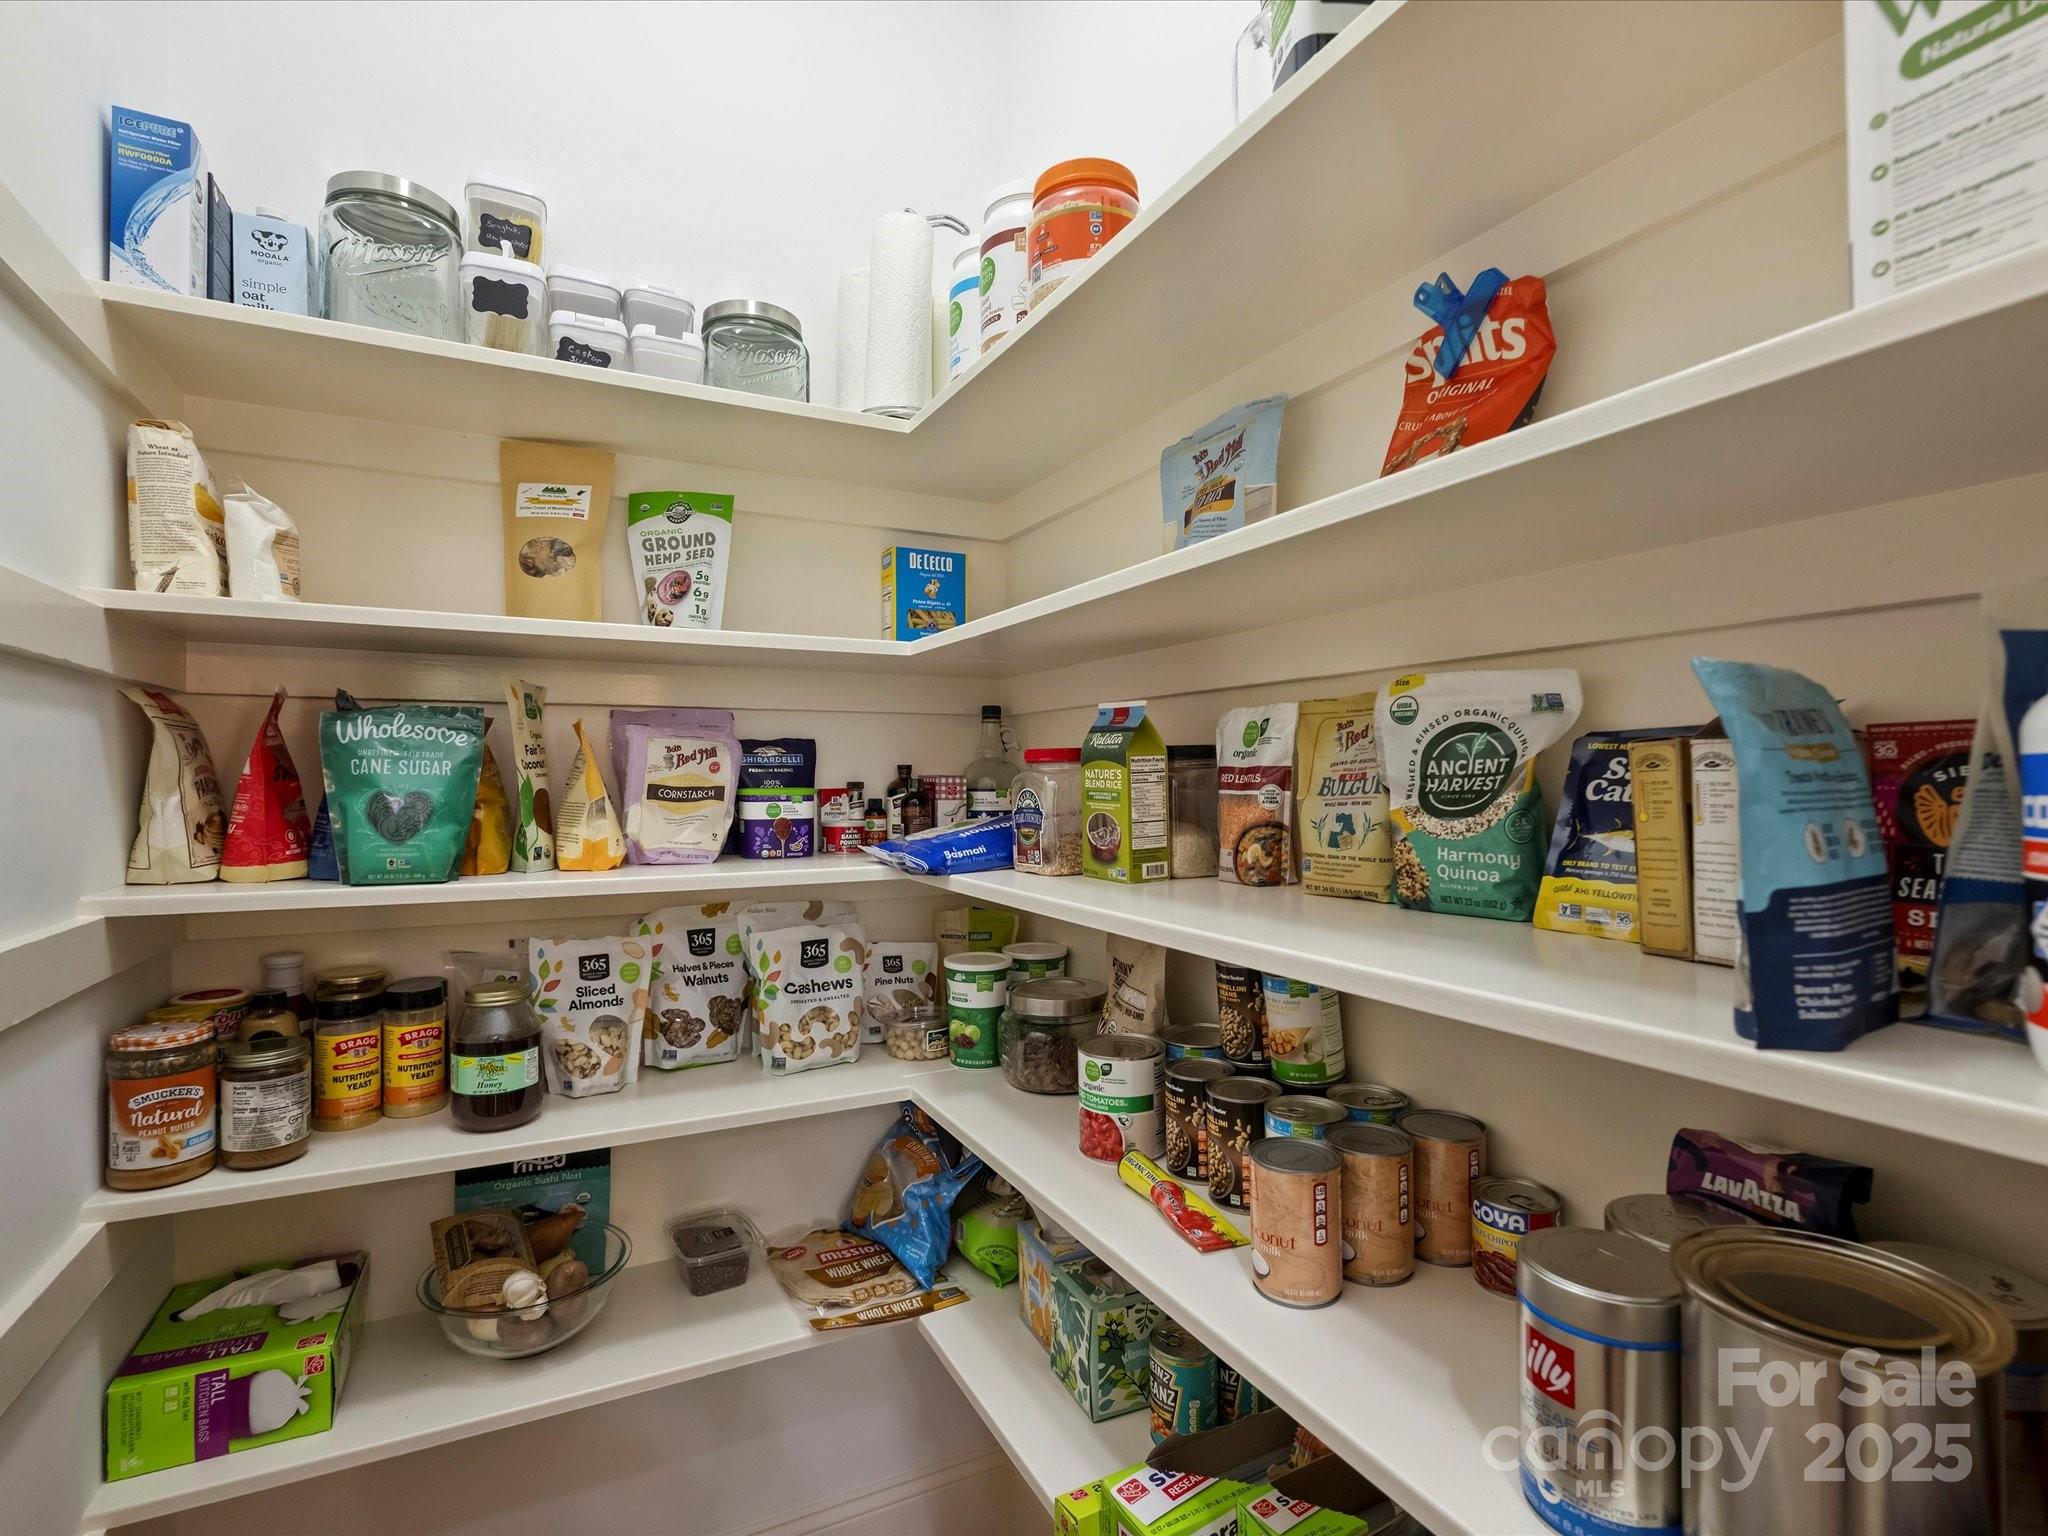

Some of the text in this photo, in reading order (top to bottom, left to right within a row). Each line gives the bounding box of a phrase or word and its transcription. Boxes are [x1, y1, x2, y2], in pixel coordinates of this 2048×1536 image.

[118, 148, 172, 166] RWF0900A
[251, 250, 288, 262] MOOALA
[330, 237, 449, 263] Mason
[258, 258, 282, 267] organic
[242, 278, 287, 295] simple
[242, 291, 265, 302] oat
[719, 342, 803, 365] Mason
[640, 528, 683, 537] ORGANIC
[642, 532, 716, 552] GROUND
[644, 548, 714, 566] HEMP SEED
[695, 571, 709, 581] 5g
[1394, 679, 1410, 687] Size
[336, 713, 468, 746] Wholesome
[1090, 733, 1123, 747] Ralston
[1345, 723, 1368, 753] Red
[524, 744, 538, 756] Fair
[1588, 742, 1618, 750] LOWEST
[675, 746, 718, 770] Red Mill
[1233, 750, 1257, 760] organic
[1406, 759, 1416, 800] WASHED
[1416, 714, 1449, 744] RINSED
[1454, 708, 1508, 724] ORGANIC
[351, 758, 451, 776] CANE SUGAR
[1085, 769, 1122, 779] NATURE'S
[1427, 758, 1510, 776] ANCIENT
[1085, 780, 1122, 790] BLEND RICE
[1221, 773, 1261, 784] RED LENTILS
[1425, 775, 1504, 792] HARVEST
[658, 788, 715, 799] CORNSTARCH
[944, 845, 987, 859] Basmati
[1437, 847, 1521, 869] Harmony
[1577, 860, 1599, 868] BRAND
[1437, 864, 1500, 882] Quinoa
[1574, 887, 1589, 895] AHI
[1454, 897, 1464, 905] WT
[691, 933, 712, 946] 365
[803, 944, 826, 958] 365
[582, 957, 606, 972] 365
[672, 963, 701, 973] Halves
[709, 960, 734, 969] Pieces
[885, 959, 901, 967] 365
[683, 973, 729, 987] Walnuts
[784, 978, 853, 995] Cashews
[875, 976, 914, 986] Pine Nuts
[576, 984, 616, 998] Sliced
[823, 993, 849, 1001] UNSALTED
[568, 996, 624, 1011] Almonds
[404, 1028, 439, 1040] BRAGG
[340, 1037, 376, 1050] BRAGG
[398, 1059, 442, 1072] NUTRITIONAL
[333, 1069, 379, 1083] NUTRITIONAL
[411, 1070, 434, 1080] YEAST
[347, 1080, 372, 1091] YEAST
[1083, 1081, 1105, 1092] organic
[133, 1087, 202, 1107] SMUCKER'S
[1086, 1094, 1125, 1106] TOMATOES
[131, 1101, 203, 1127] Natural
[138, 1121, 195, 1137] PEANUT BUTTER
[1126, 1156, 1146, 1173] ORGANIC
[1145, 1171, 1166, 1191] TOMATO
[494, 1172, 582, 1191] Organic Sushi Nori
[1701, 1172, 1800, 1222] LAVAZZA
[1473, 1200, 1525, 1232] GOYA
[825, 1253, 894, 1280] WHOLE WHEAT
[856, 1297, 925, 1322] WHOLE WHEAT
[1528, 1339, 1571, 1392] illy
[210, 1372, 227, 1405] TALL
[198, 1377, 210, 1442] KITCHEN BAGS
